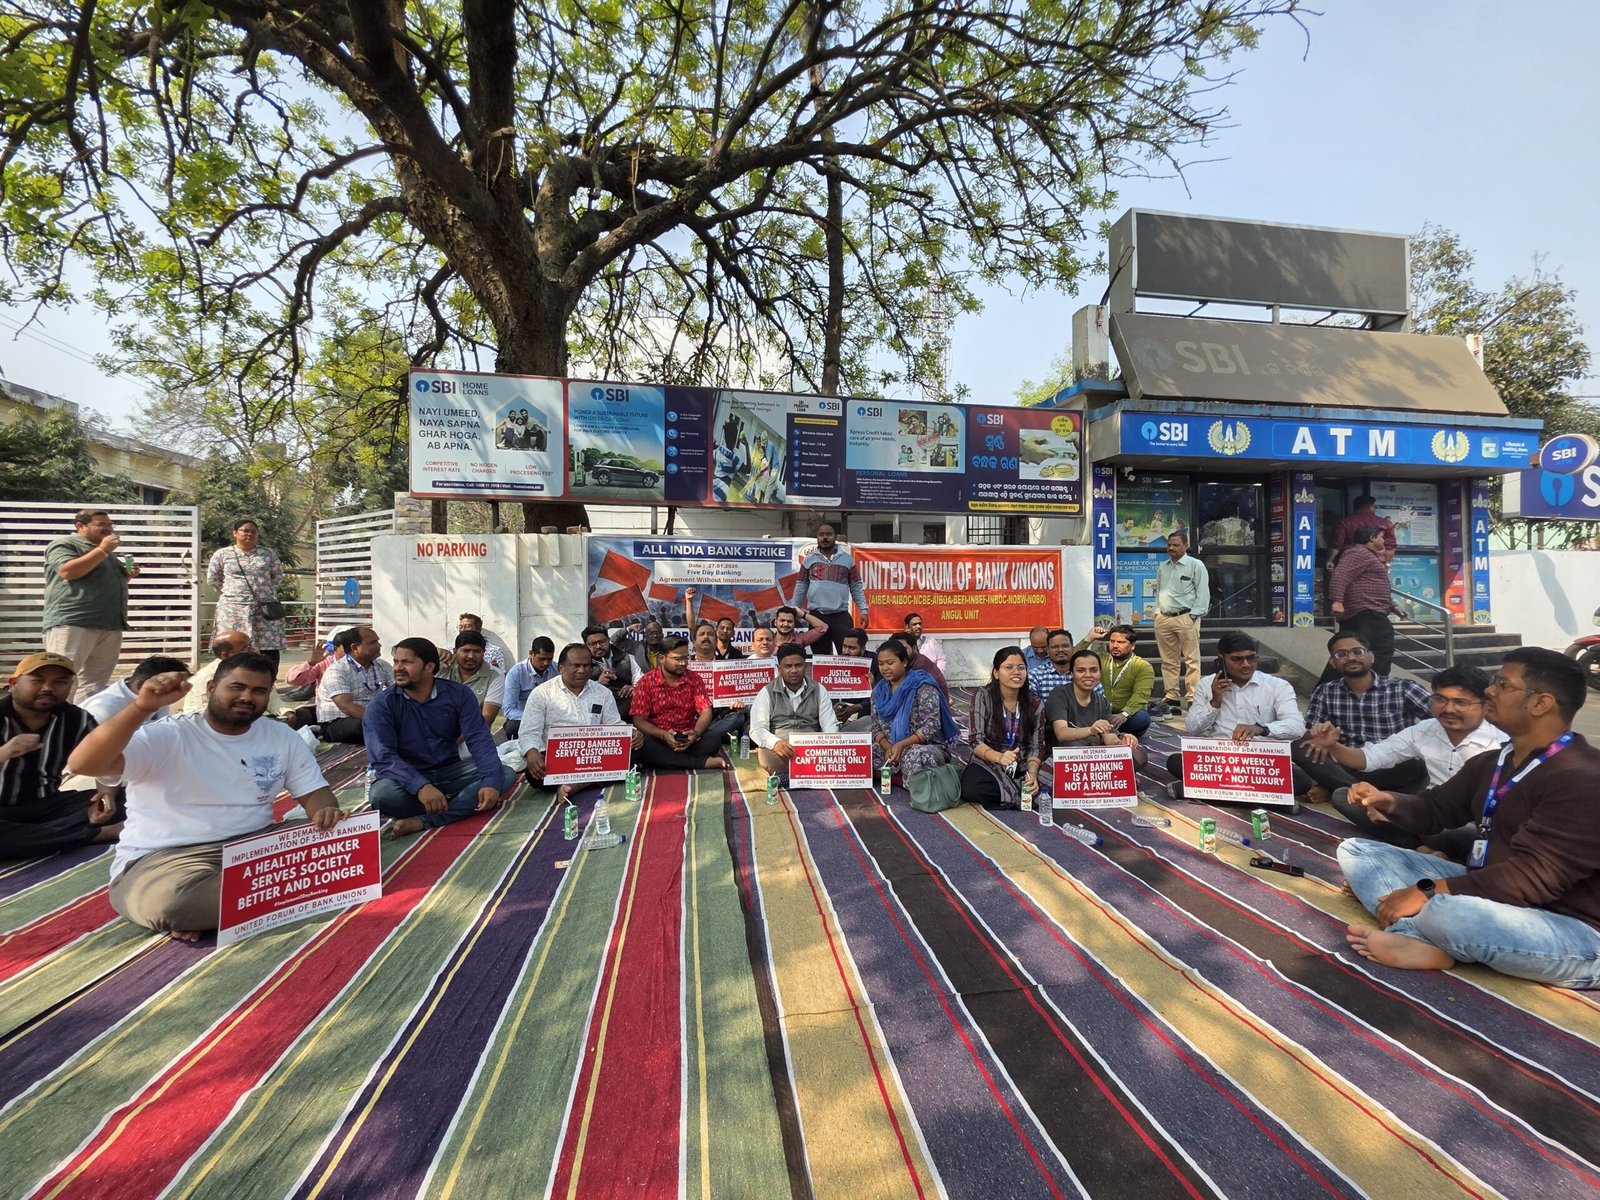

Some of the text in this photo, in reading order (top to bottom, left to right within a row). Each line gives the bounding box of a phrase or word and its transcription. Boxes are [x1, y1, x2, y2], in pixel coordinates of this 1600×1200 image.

[1175, 340, 1252, 376] SBI
[431, 380, 456, 394] SBI
[462, 382, 489, 390] HOME
[606, 388, 630, 402] SBI
[826, 402, 840, 411] SBI
[867, 407, 883, 417] SBI
[419, 407, 481, 419] NAYI UMEED,
[419, 419, 481, 429] NAYA SAPNA
[986, 413, 1004, 425] SBI
[419, 430, 481, 440] GHAR HOGA,
[1159, 422, 1189, 442] SBI
[427, 441, 473, 451] AB APNA.
[1552, 447, 1577, 461] SBI
[1101, 467, 1113, 475] SBI
[1301, 473, 1314, 481] SBI
[417, 542, 487, 557] NO PARKING
[642, 544, 786, 557] ALL INDIA BANK STRIKE
[1273, 545, 1284, 553] SBI
[860, 560, 1055, 591] UNITED FORUM OF BANK UNIONS
[1273, 585, 1285, 593] SBI
[941, 610, 980, 620] ANGUL UNIT
[828, 669, 851, 677] JUSTICE
[834, 677, 862, 685] BANKERS
[559, 739, 621, 749] RESTED BANKERS
[555, 747, 623, 758] SERVE CUSTOMERS
[805, 748, 857, 757] COMMITMENTS
[576, 756, 602, 765] BETTER
[795, 756, 867, 764] CAN'T REMAIN ONLY
[1197, 755, 1275, 767] 2 DAYS OF WEEKLY
[815, 764, 847, 772] ON FILES
[1064, 762, 1124, 773] 5-DAY BANKING
[1193, 763, 1213, 772] REST
[1215, 765, 1223, 773] IS
[1232, 766, 1266, 775] MATTER
[1268, 768, 1281, 776] OF
[1073, 773, 1080, 782] IS
[1082, 772, 1088, 781] A
[1090, 772, 1112, 781] RIGHT
[1190, 772, 1223, 782] DIGNITY
[1231, 775, 1249, 784] NOT
[1251, 776, 1285, 786] LUXURY
[1064, 780, 1128, 791] NOT A PRIVILEGE
[278, 832, 291, 842] WE
[231, 823, 372, 864] IMPLEMENTATION OF 5-DAY BANKING
[242, 838, 360, 880] A HEALTHY BANKER
[250, 853, 352, 891] SERVES SOCIETY
[237, 864, 365, 911] BETTER AND LONGER
[234, 888, 368, 935] UNITED FORUM OF BANK UNIONS
